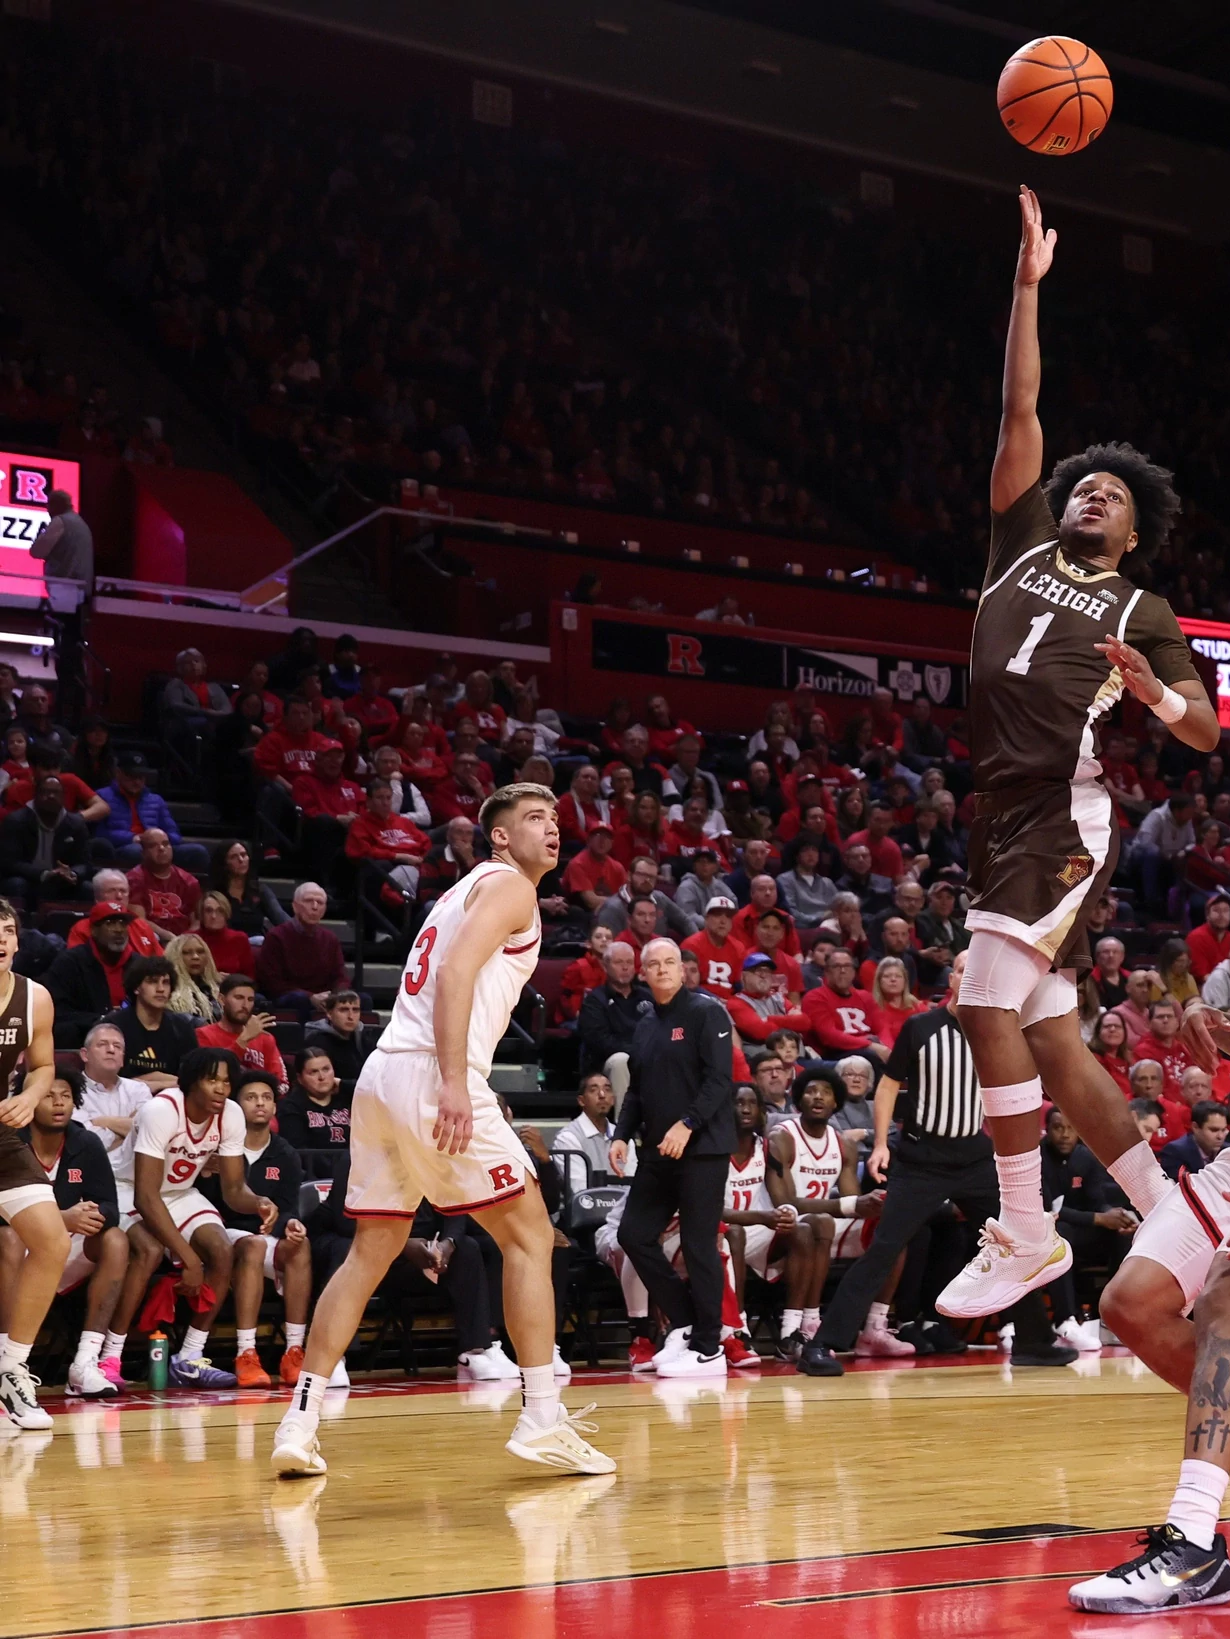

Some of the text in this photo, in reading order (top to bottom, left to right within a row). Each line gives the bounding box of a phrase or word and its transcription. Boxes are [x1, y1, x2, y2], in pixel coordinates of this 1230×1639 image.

[16, 470, 48, 503] R
[1017, 566, 1109, 621] LEHIGH
[667, 634, 705, 676] R
[1005, 611, 1055, 676] 1
[706, 959, 733, 990] R
[670, 1026, 684, 1041] R
[836, 1006, 871, 1035] R
[330, 1126, 346, 1143] R
[68, 1168, 83, 1183] R
[167, 1158, 197, 1184] 9
[265, 1166, 281, 1181] R
[488, 1163, 519, 1191] R
[732, 1190, 752, 1211] 11
[806, 1180, 829, 1199] 21
[151, 1347, 163, 1362] G
